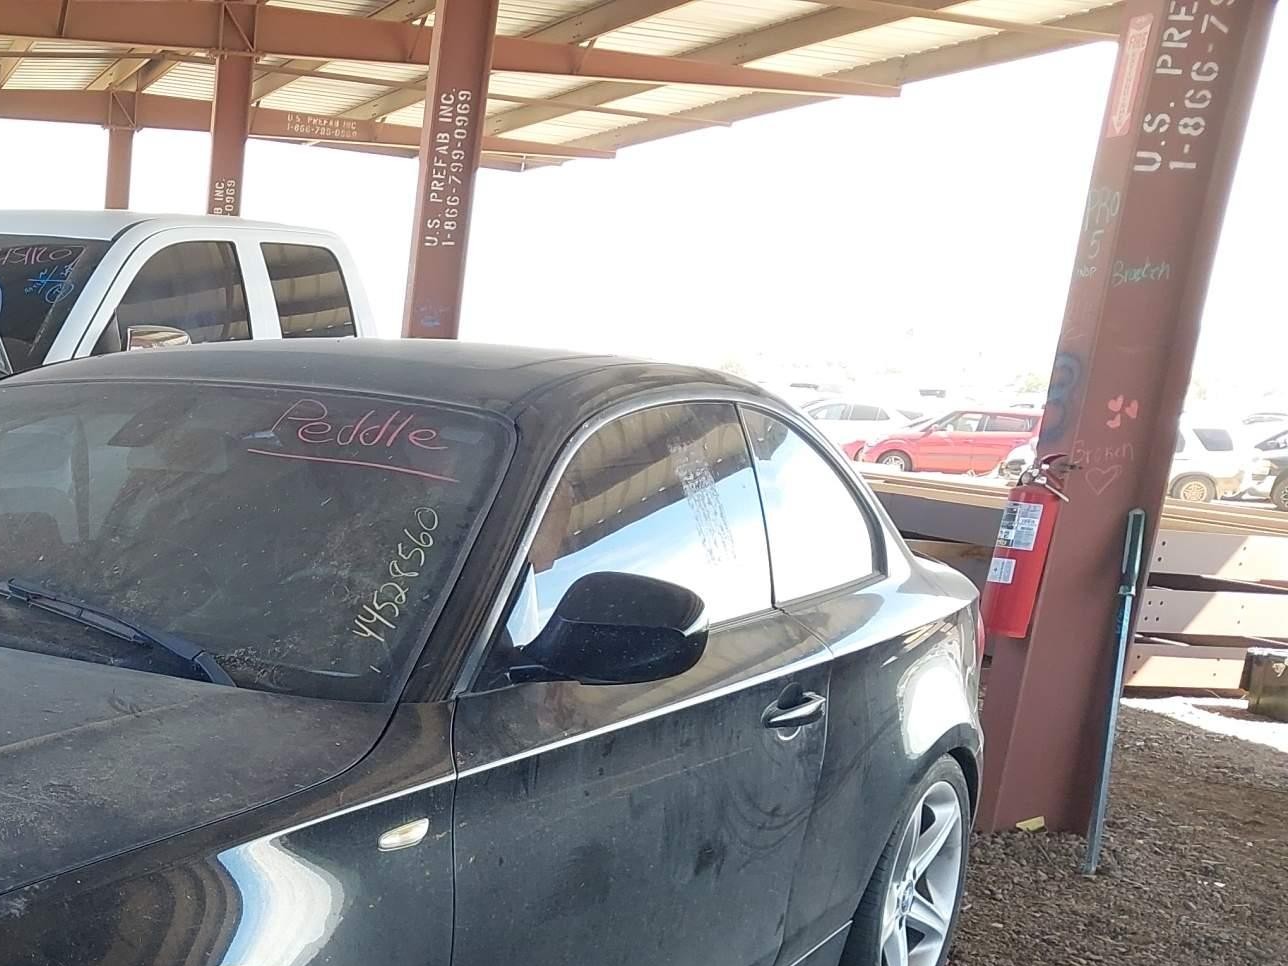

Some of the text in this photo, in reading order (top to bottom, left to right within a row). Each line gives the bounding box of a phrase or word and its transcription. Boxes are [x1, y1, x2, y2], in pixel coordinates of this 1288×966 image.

[1133, 101, 1175, 172] U.S.
[1169, 0, 1235, 170] 1-866-7
[424, 88, 456, 247] U.S. PREFAB INC.
[441, 90, 472, 246] 1-866-799-0969
[270, 399, 448, 451] Peddle
[352, 506, 439, 642] 44528560
